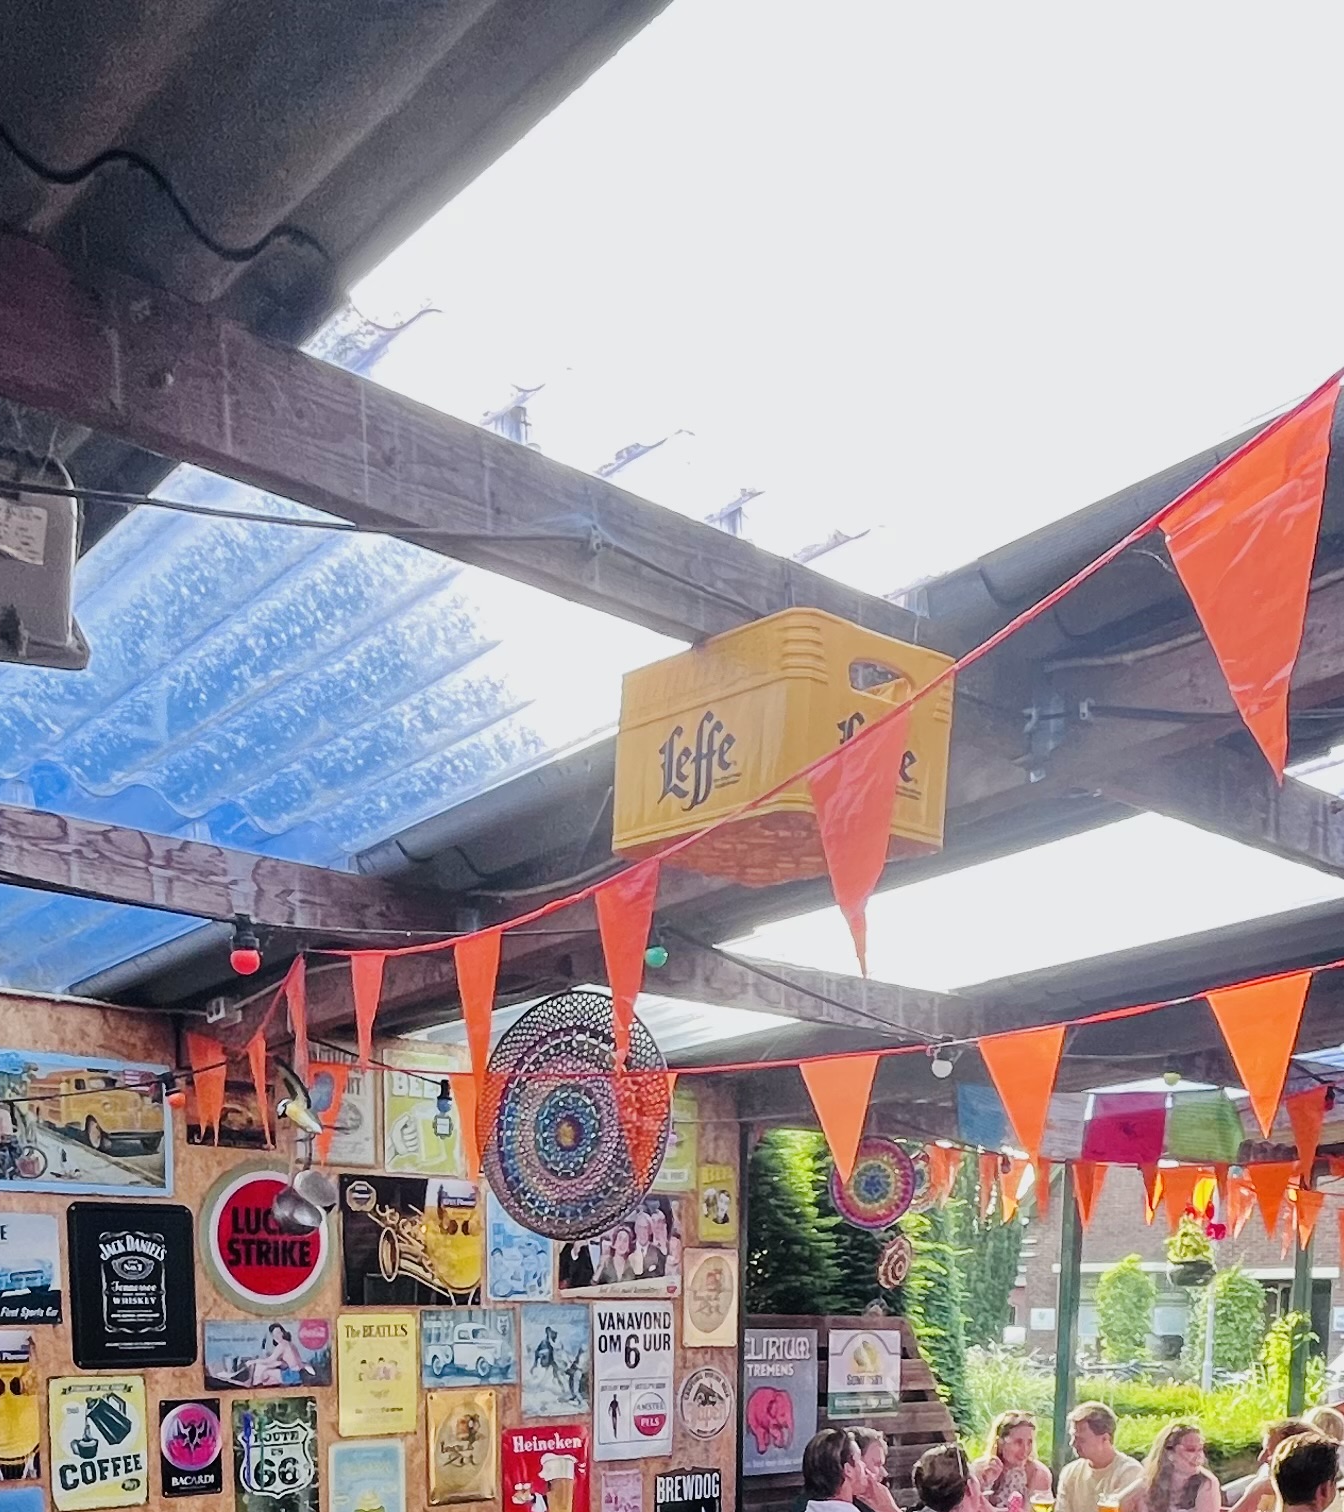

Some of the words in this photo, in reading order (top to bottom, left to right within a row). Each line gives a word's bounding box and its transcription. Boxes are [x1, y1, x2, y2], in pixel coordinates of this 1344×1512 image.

[657, 710, 737, 812] Leffe
[99, 1239, 126, 1260] JACK
[228, 1240, 312, 1267] STRIKE
[112, 1297, 157, 1305] WHISKEY
[344, 1324, 361, 1338] The
[362, 1323, 408, 1338] BEATLES
[597, 1311, 671, 1330] VANAVOND
[598, 1334, 622, 1353] OM
[624, 1334, 641, 1369] 6
[643, 1333, 671, 1352] UUR
[746, 1363, 794, 1377] TREMENS
[640, 1417, 661, 1428] PILS
[254, 1431, 300, 1442] ROUTE
[512, 1432, 583, 1453] Heineken
[59, 1454, 143, 1491] COFFEE
[171, 1474, 215, 1487] BACARDI
[254, 1456, 299, 1487] 66
[656, 1472, 720, 1504] BREWDOG
